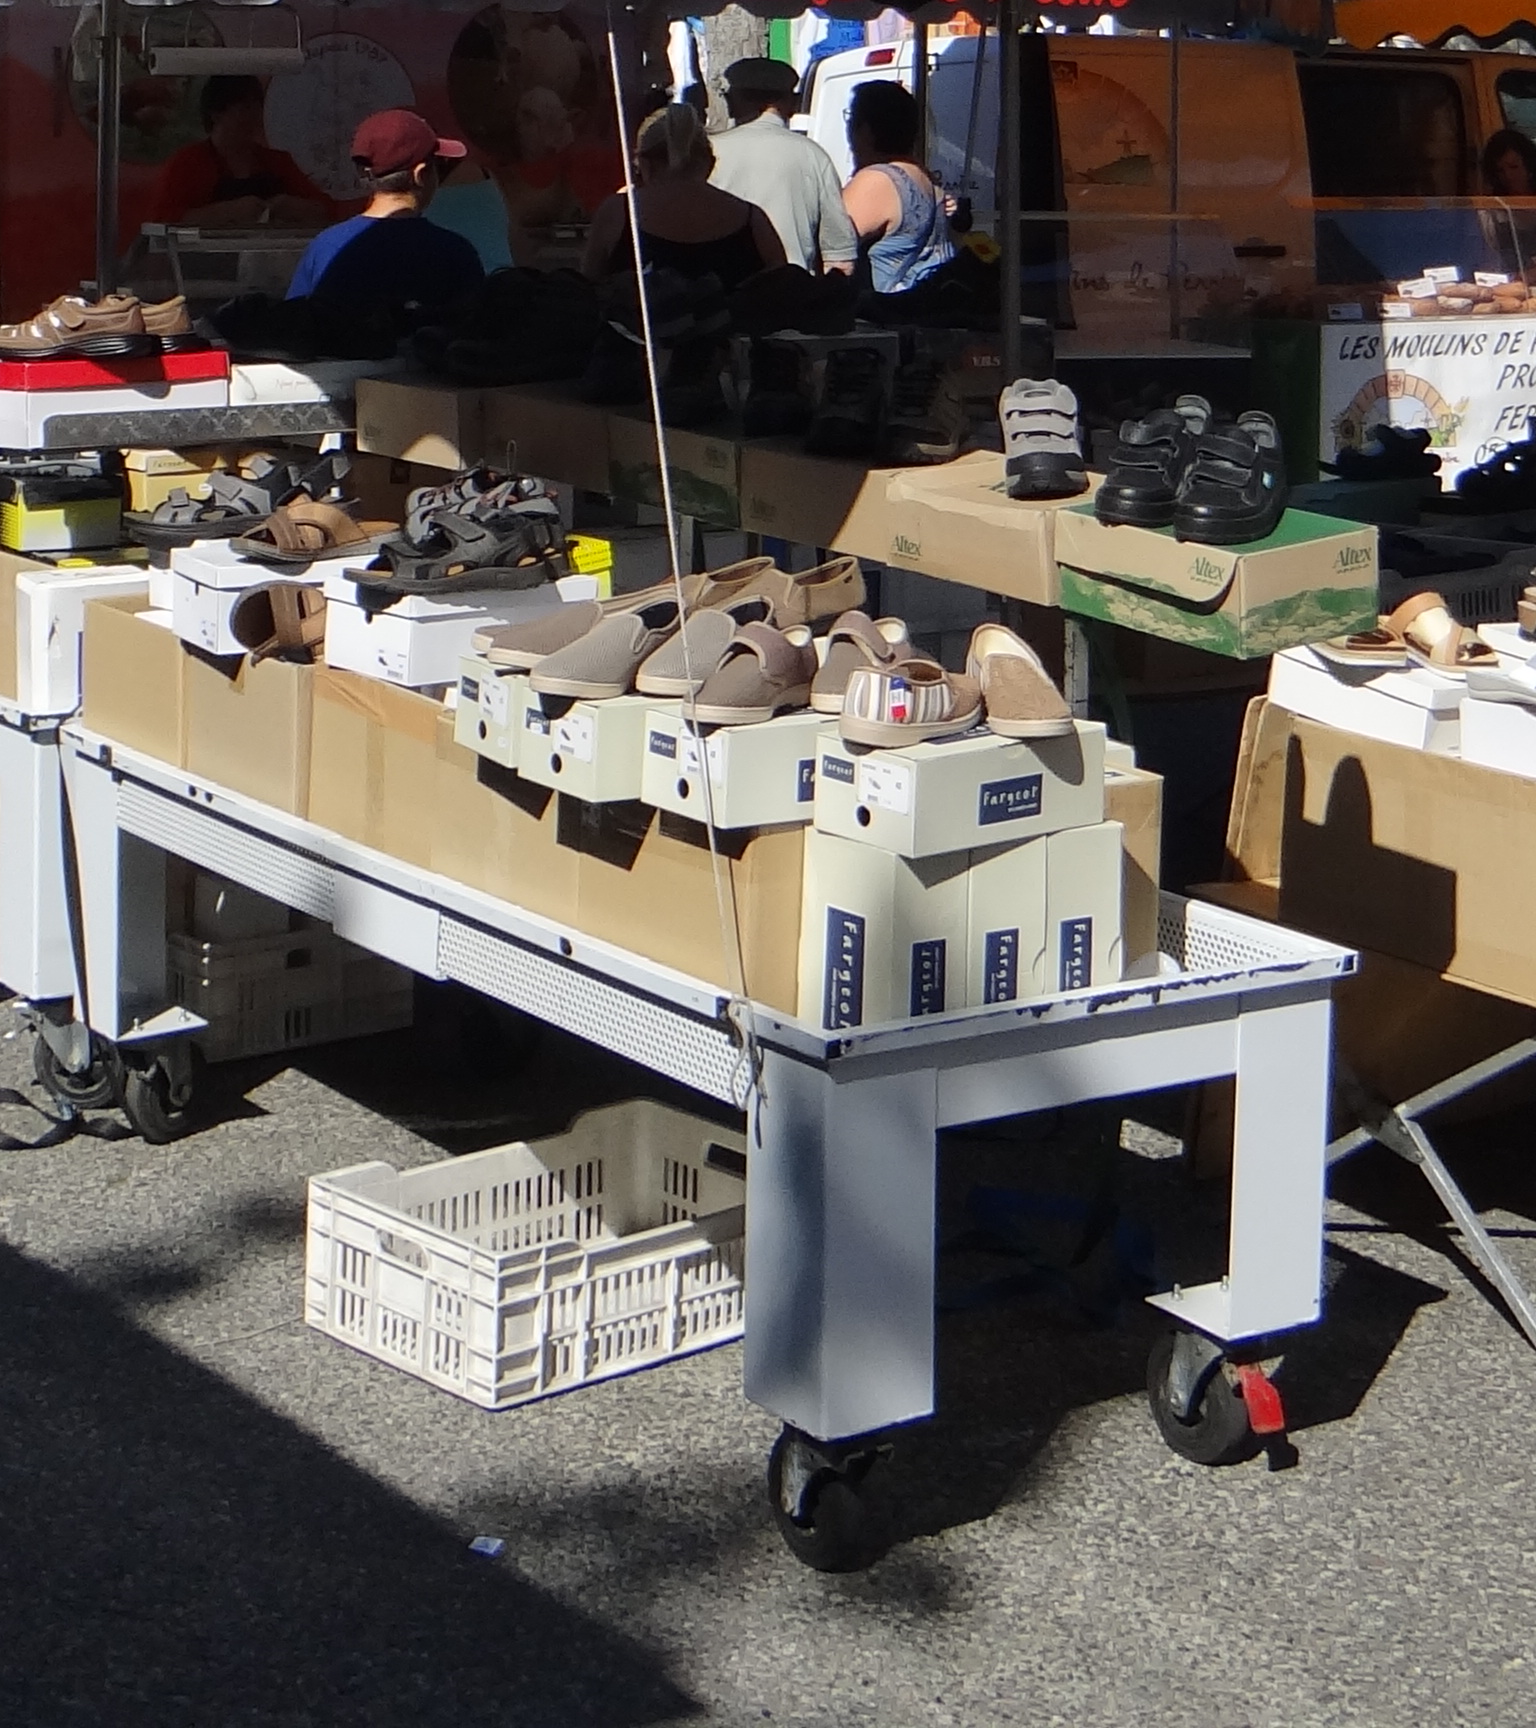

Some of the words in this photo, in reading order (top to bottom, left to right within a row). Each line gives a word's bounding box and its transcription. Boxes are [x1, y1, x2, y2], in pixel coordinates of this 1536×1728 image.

[1339, 335, 1380, 361] LES
[1384, 332, 1489, 361] MOULINS
[1493, 330, 1525, 356] DE
[890, 534, 924, 557] Altex
[1331, 546, 1372, 569] Altex
[1187, 556, 1225, 582] Altex
[982, 784, 1039, 808] Fargeot
[996, 934, 1013, 1001] Fargeo
[1070, 923, 1086, 988] Fargeo
